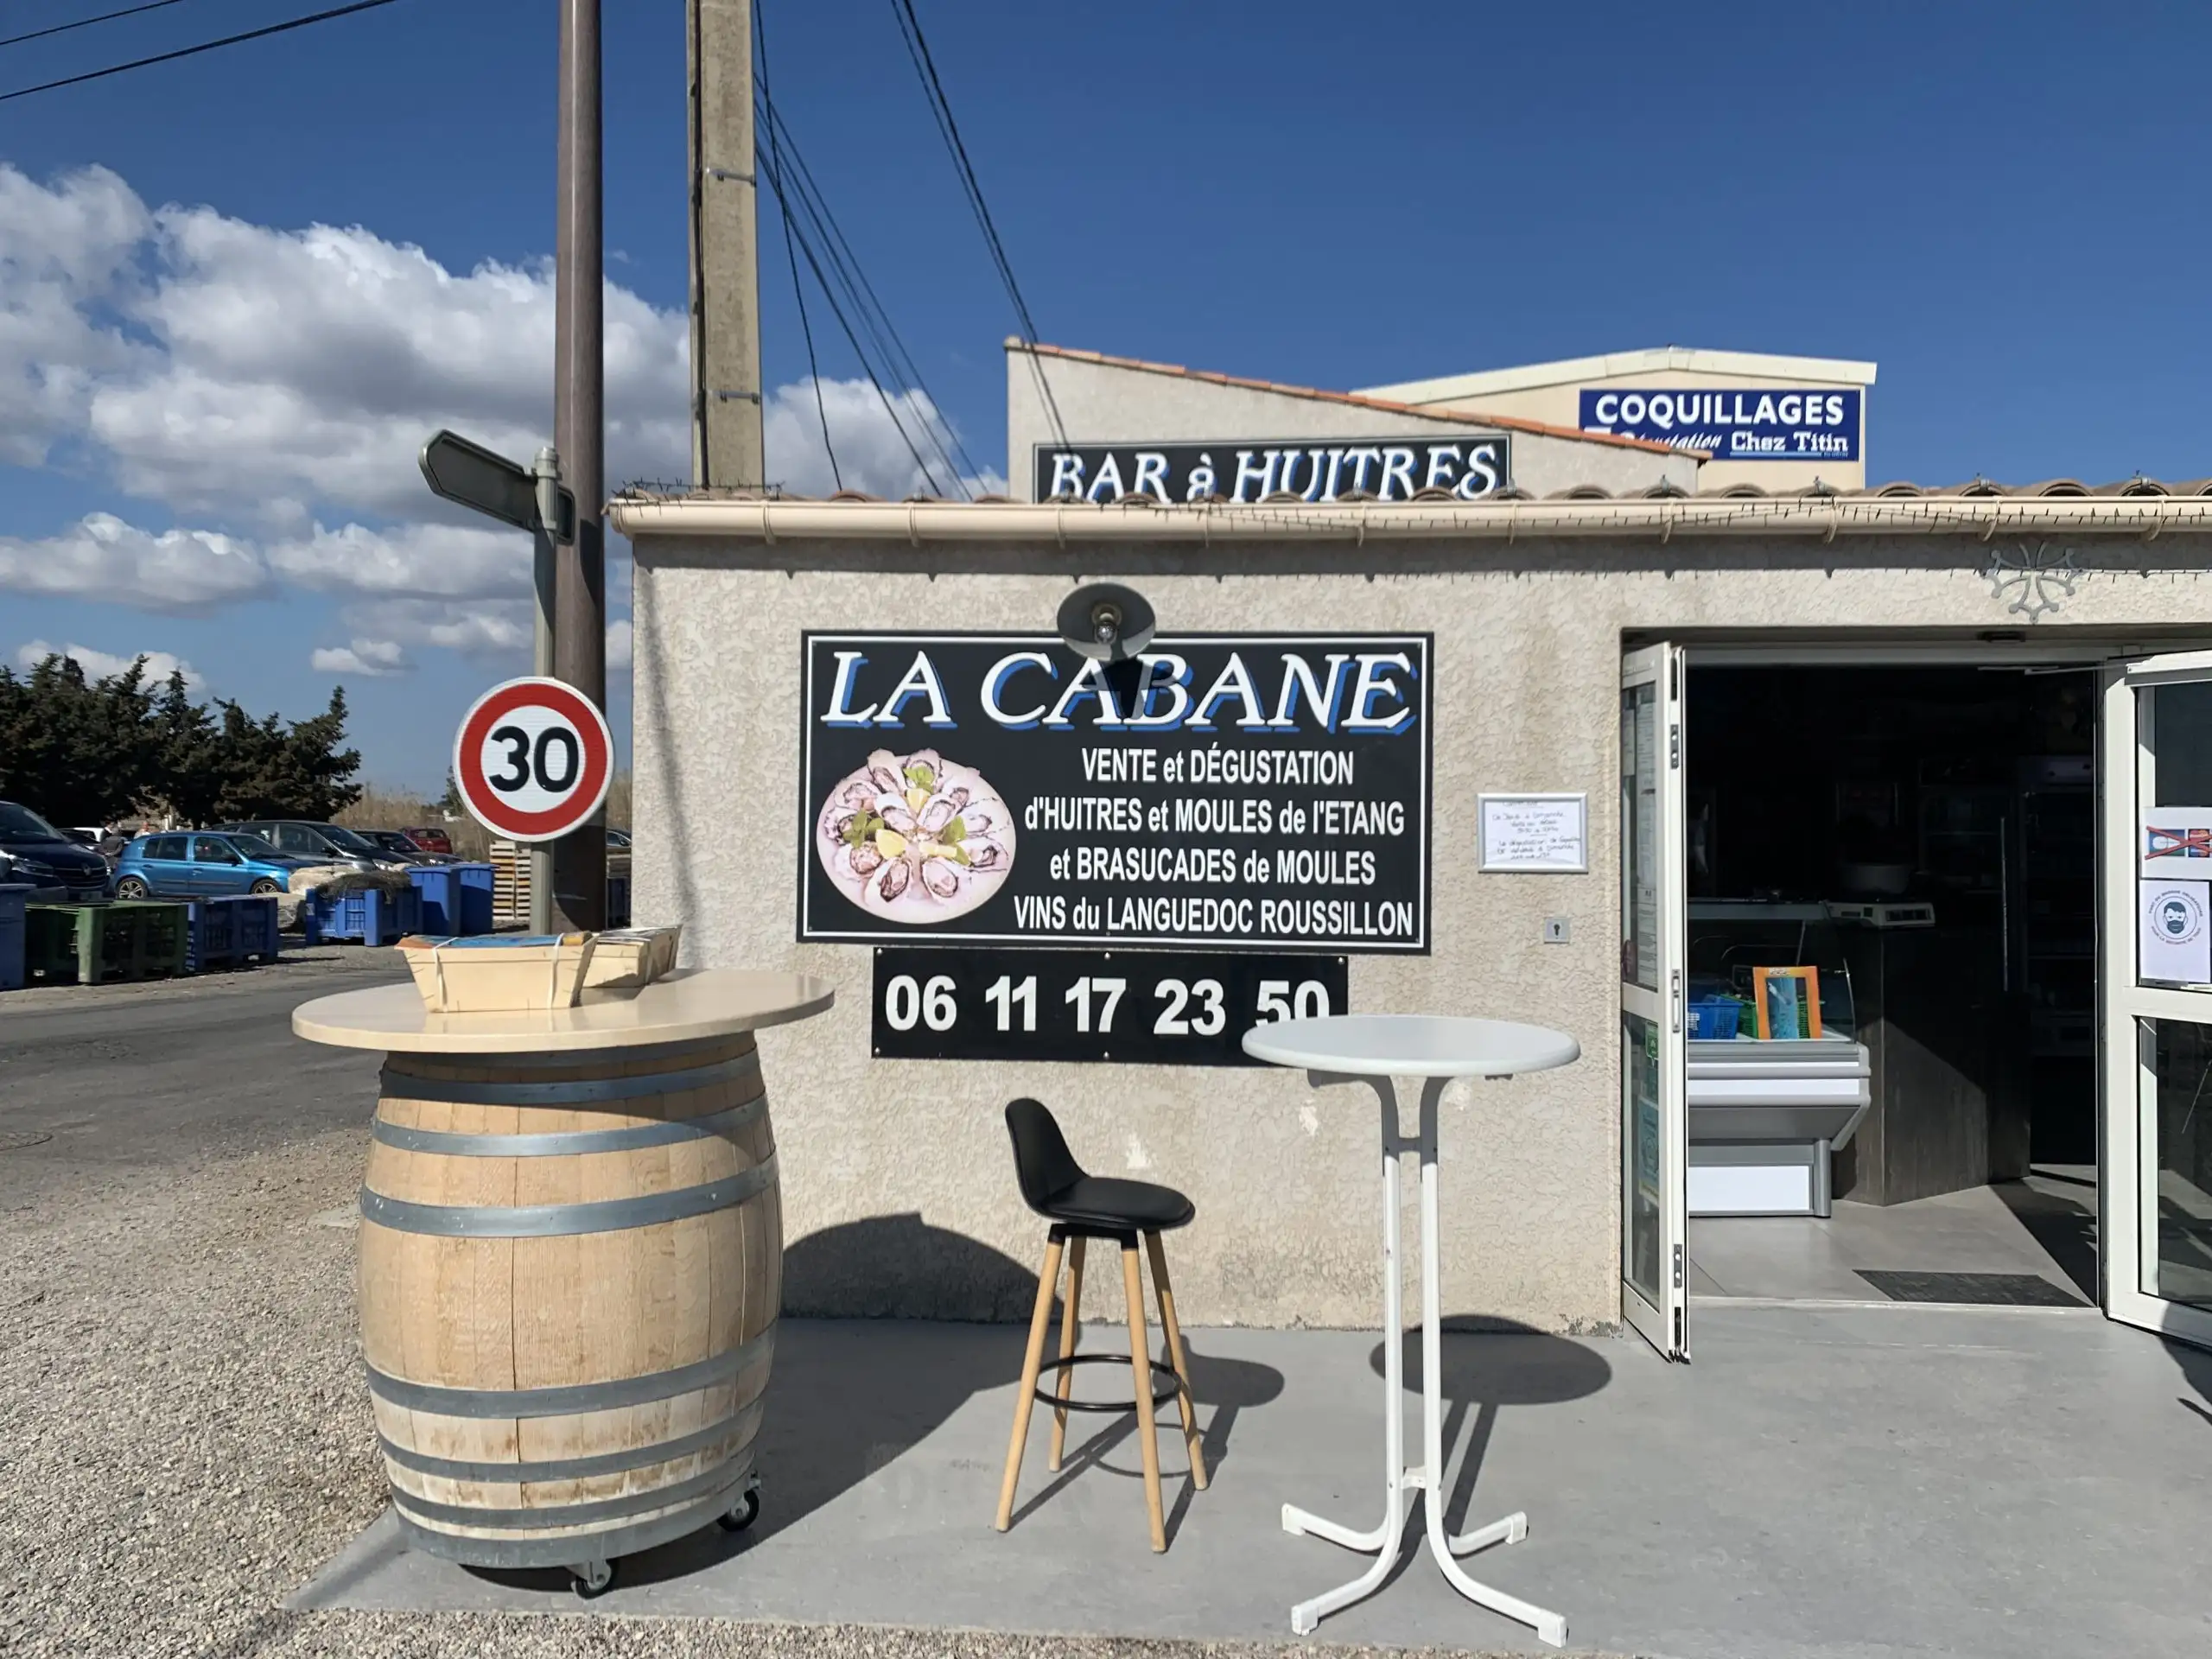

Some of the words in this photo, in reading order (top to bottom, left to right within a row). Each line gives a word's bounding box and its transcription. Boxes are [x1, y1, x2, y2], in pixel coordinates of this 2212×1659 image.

[1595, 394, 1844, 429] COQUILLAGES
[1731, 431, 1786, 452] Chez
[1792, 431, 1849, 452] Titin
[1050, 449, 1170, 505] BAR
[1188, 453, 1218, 504] à
[1230, 443, 1498, 504] HUITRES
[818, 650, 958, 730] LA
[980, 652, 1418, 733] CABANE
[487, 725, 580, 793] 30
[1081, 747, 1157, 783] VENTE
[1163, 750, 1185, 783] et
[1190, 741, 1354, 785] DÉGUSTATION
[1024, 796, 1142, 832] d'HUITRES
[1147, 799, 1169, 832] et
[1175, 798, 1273, 834] MOULES
[1279, 800, 1306, 835] de
[1313, 800, 1405, 836] l'ETANG
[1050, 848, 1071, 880] et
[1077, 847, 1236, 883] BRASUCADES
[1243, 849, 1270, 884] de
[1276, 849, 1376, 886] MOULES
[1014, 895, 1066, 930] VINS
[1072, 896, 1100, 931] du
[1107, 897, 1254, 932] LANGUEDOC
[1261, 899, 1413, 936] ROUSSILLON
[885, 975, 957, 1032] 06
[985, 976, 1037, 1032] 11
[1065, 976, 1127, 1033] 17
[1153, 978, 1226, 1036] 23
[1255, 980, 1331, 1027] 50
